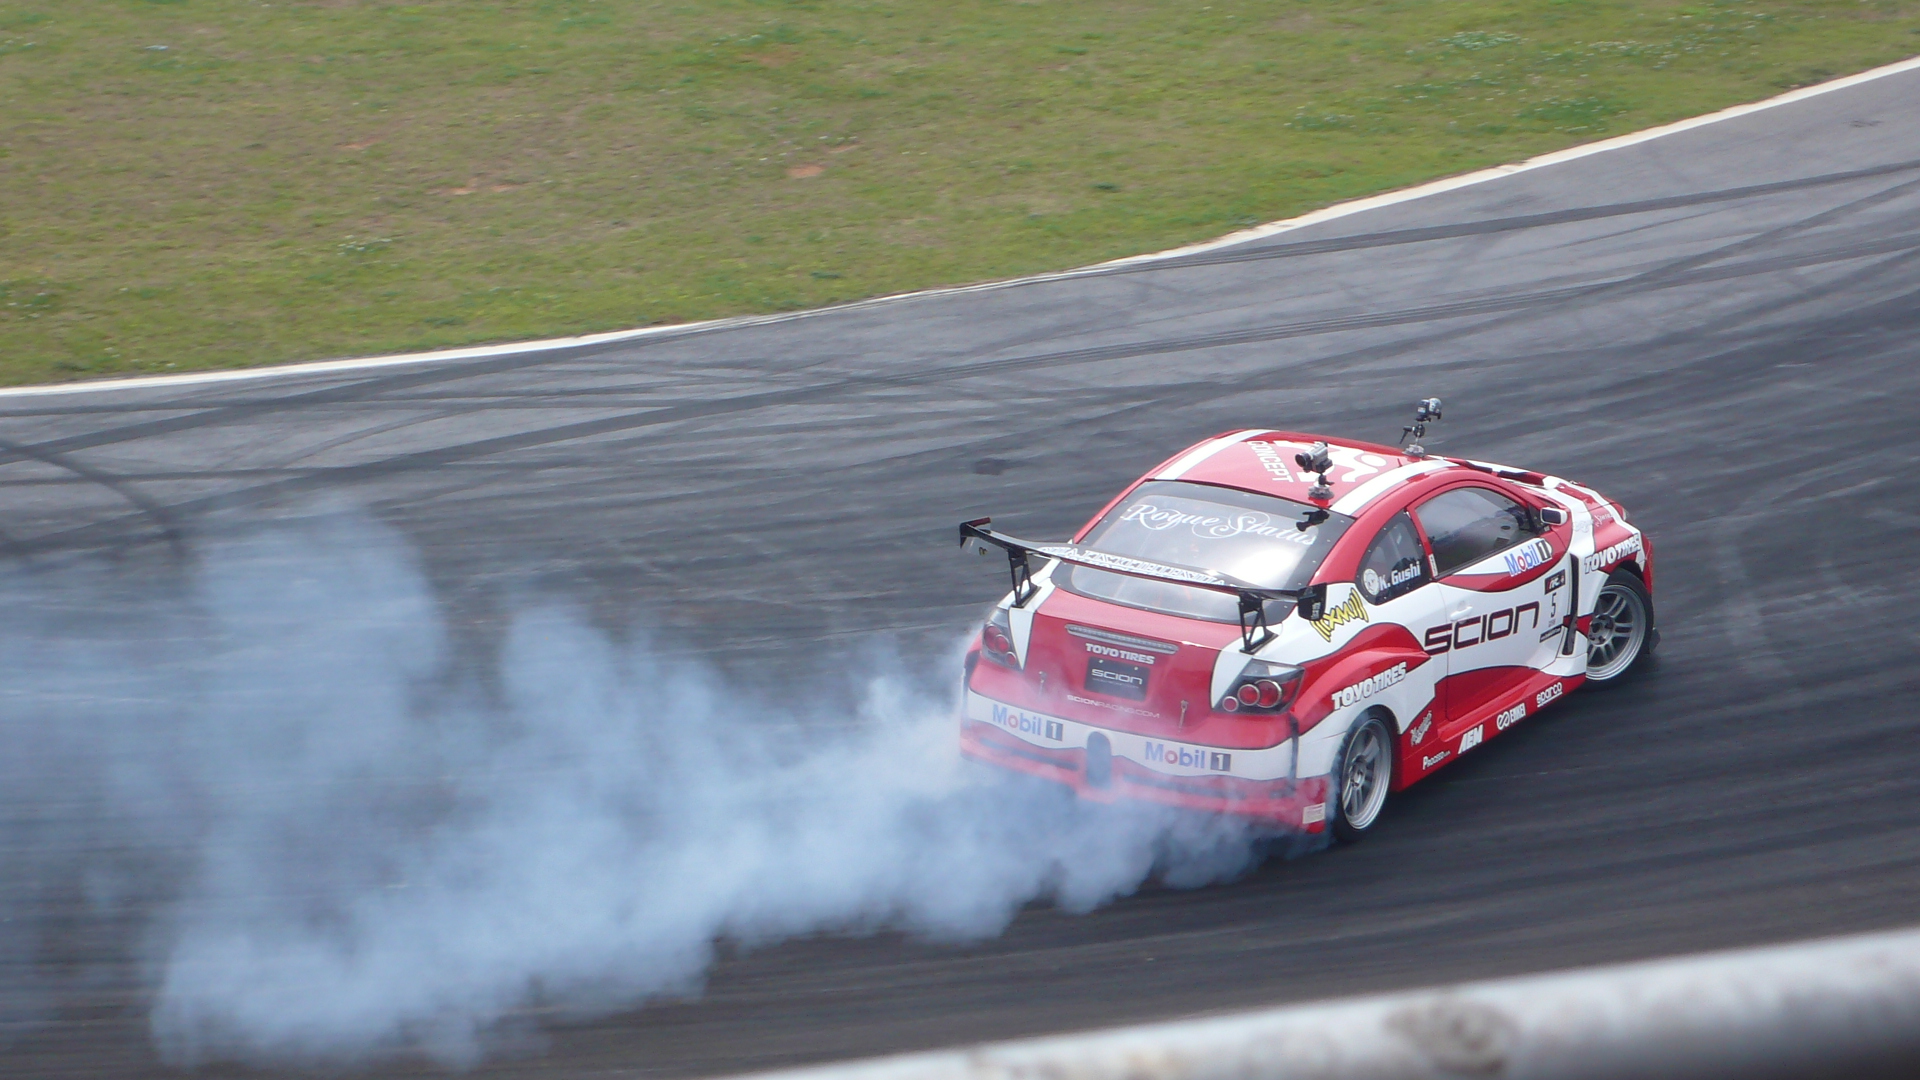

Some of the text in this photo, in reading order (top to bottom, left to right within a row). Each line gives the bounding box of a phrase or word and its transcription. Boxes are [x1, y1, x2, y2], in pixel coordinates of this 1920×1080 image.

[1247, 441, 1294, 482] CONCEPT
[1120, 504, 1317, 545] Rogue Status
[1504, 541, 1550, 577] Mobil 1
[1583, 533, 1641, 574] TOYO TIRES
[1379, 574, 1391, 591] K.
[1391, 561, 1421, 586] Gushi
[1085, 642, 1155, 664] TOYO TIRES
[1331, 661, 1407, 711] TOYO TIRES
[1536, 682, 1563, 706] sparco
[992, 704, 1041, 735] Mobil
[1145, 741, 1205, 769] Mobil
[1458, 724, 1484, 755] AEM
